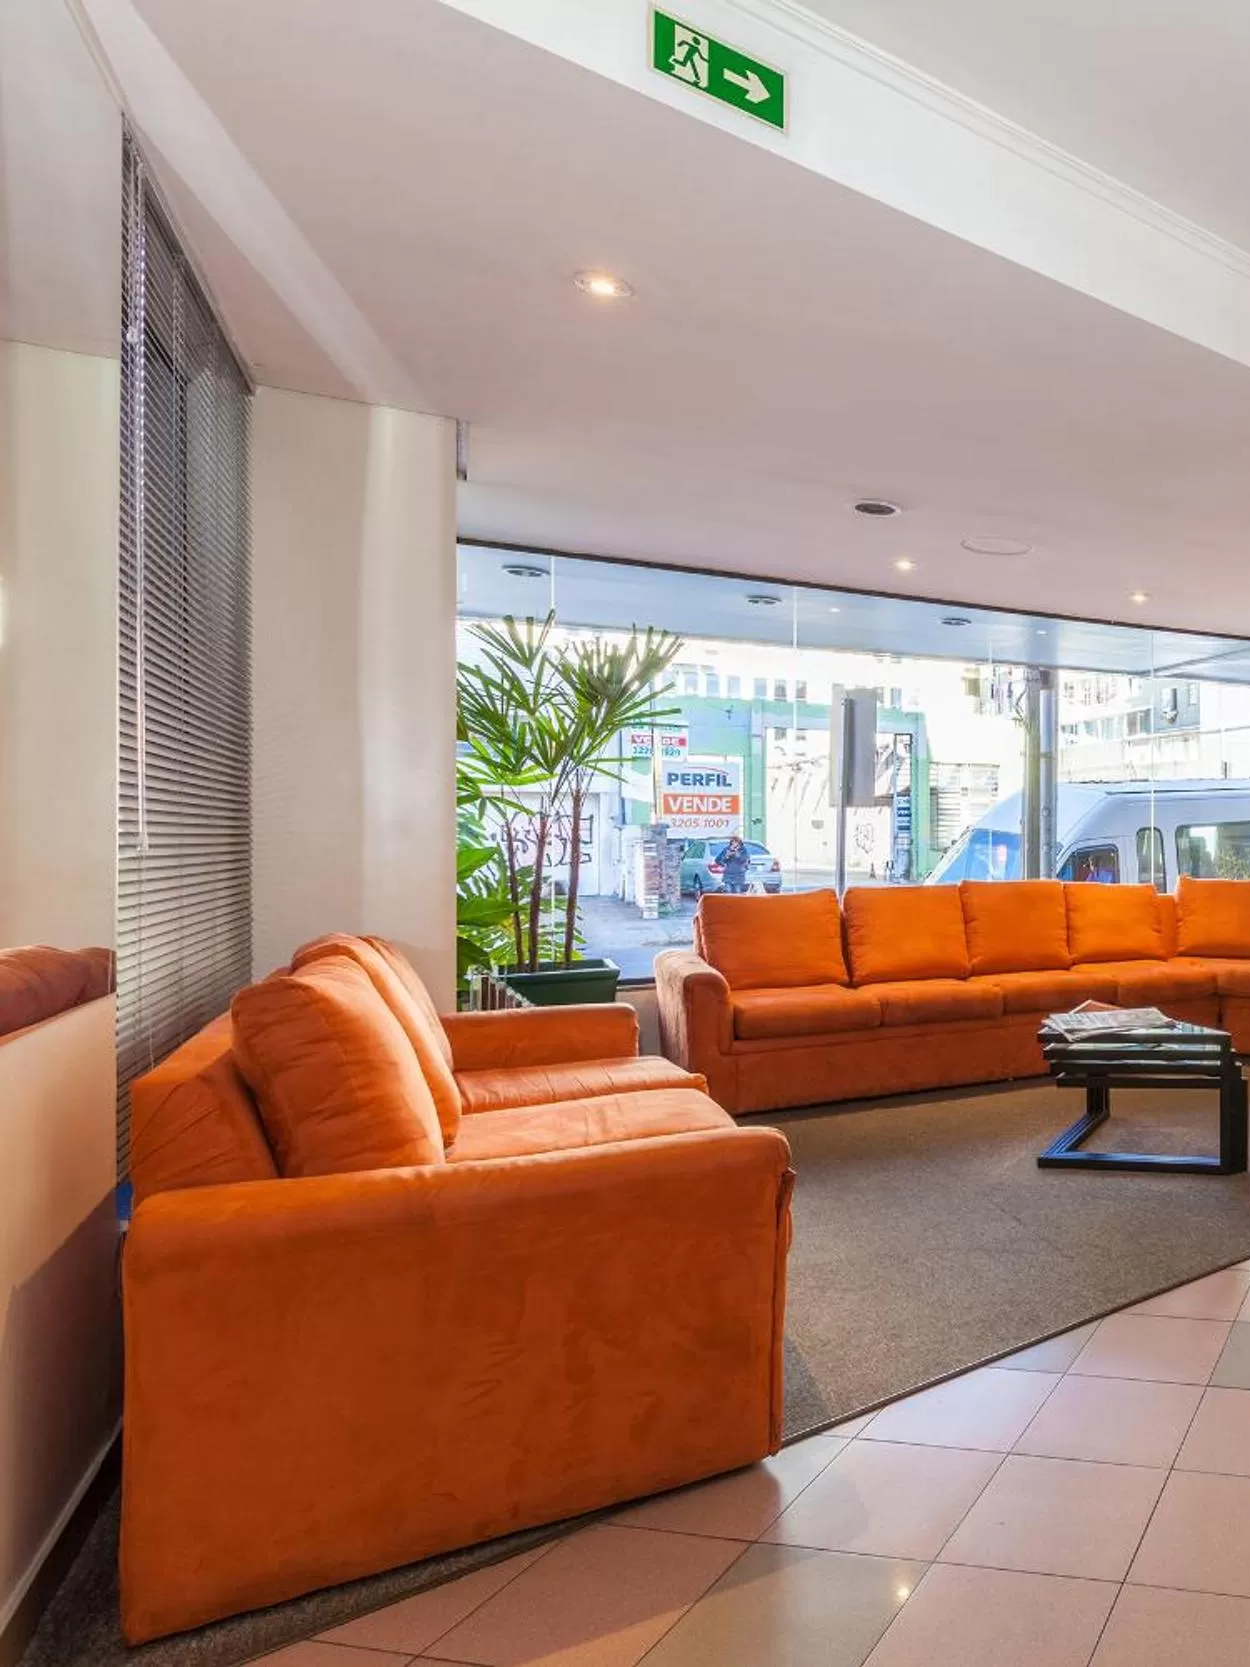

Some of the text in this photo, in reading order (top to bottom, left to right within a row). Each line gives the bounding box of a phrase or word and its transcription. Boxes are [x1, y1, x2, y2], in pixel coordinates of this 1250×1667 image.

[633, 735, 680, 746] VEDE
[667, 772, 732, 787] PERFIL
[668, 796, 732, 812] VENDE
